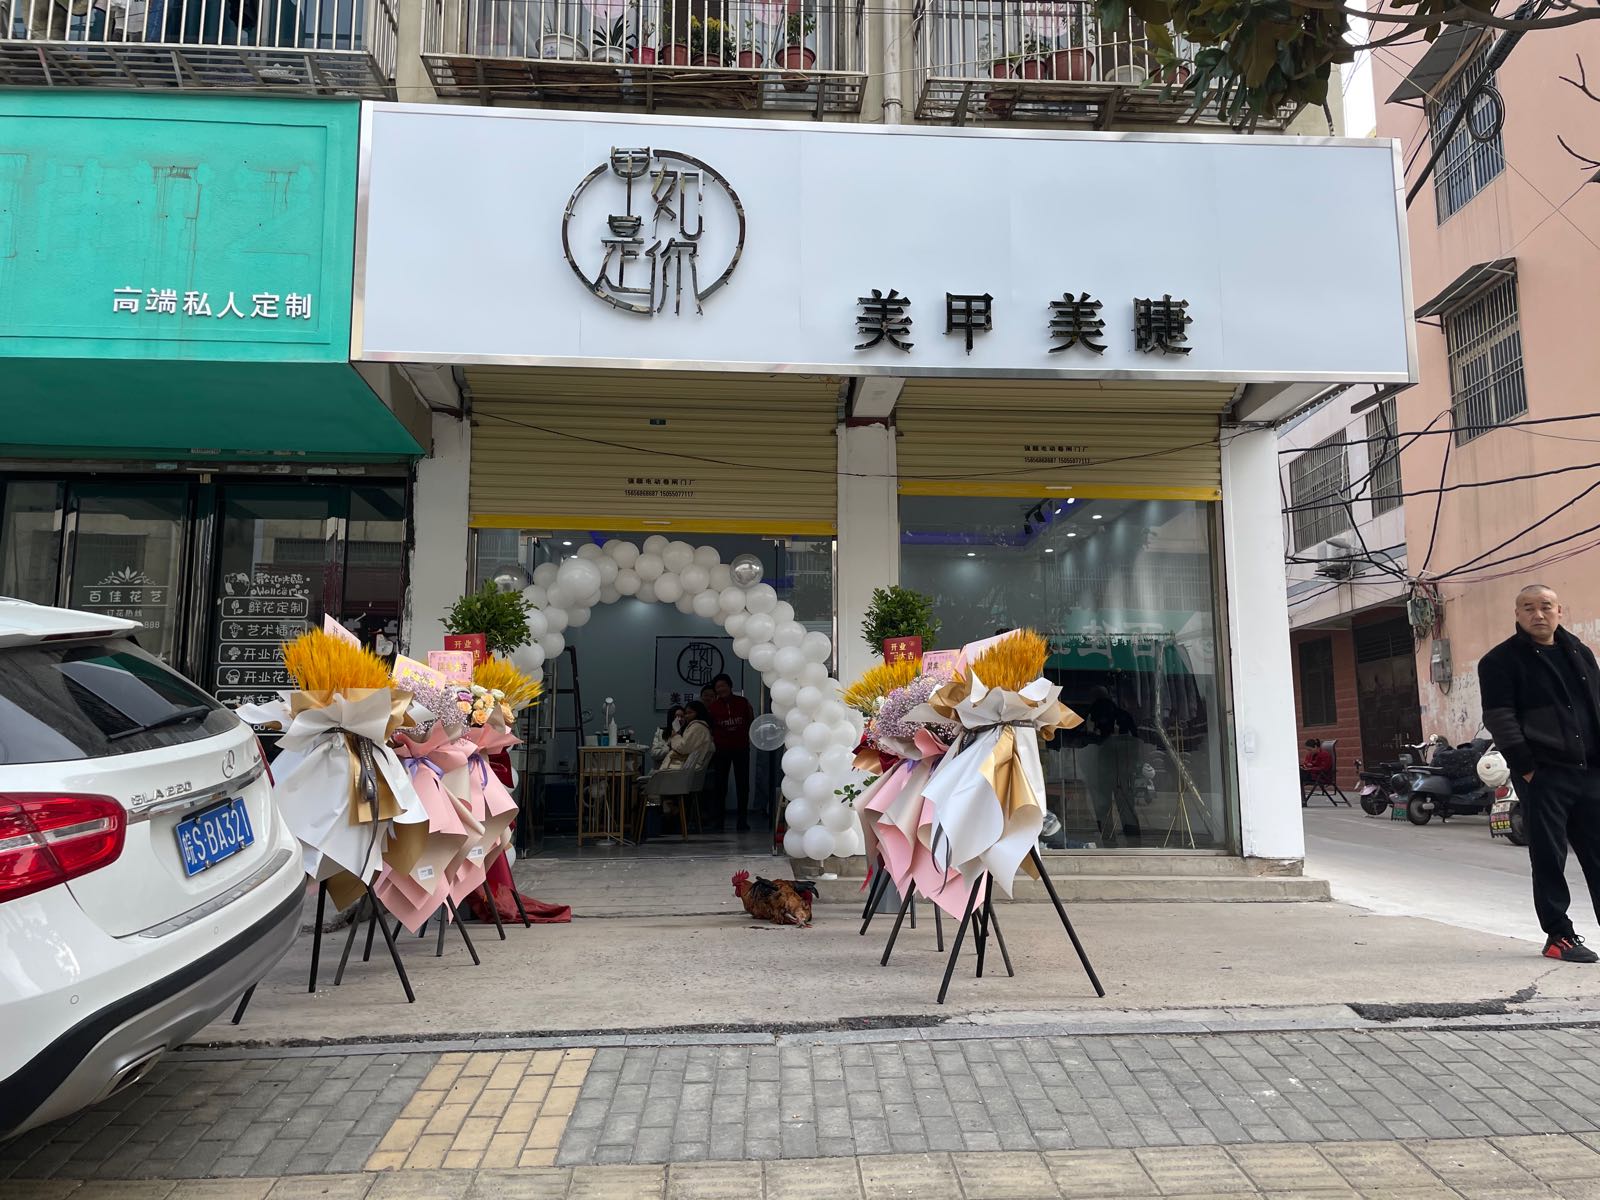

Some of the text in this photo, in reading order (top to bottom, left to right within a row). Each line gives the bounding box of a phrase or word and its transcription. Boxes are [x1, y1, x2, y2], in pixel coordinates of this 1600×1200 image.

[112, 286, 312, 319] 高端私人定制
[855, 289, 995, 356] 美甲
[89, 590, 163, 603] 百佳花艺
[248, 601, 303, 613] 鲜花定制
[454, 640, 472, 649] 开业
[890, 642, 907, 651] 开业
